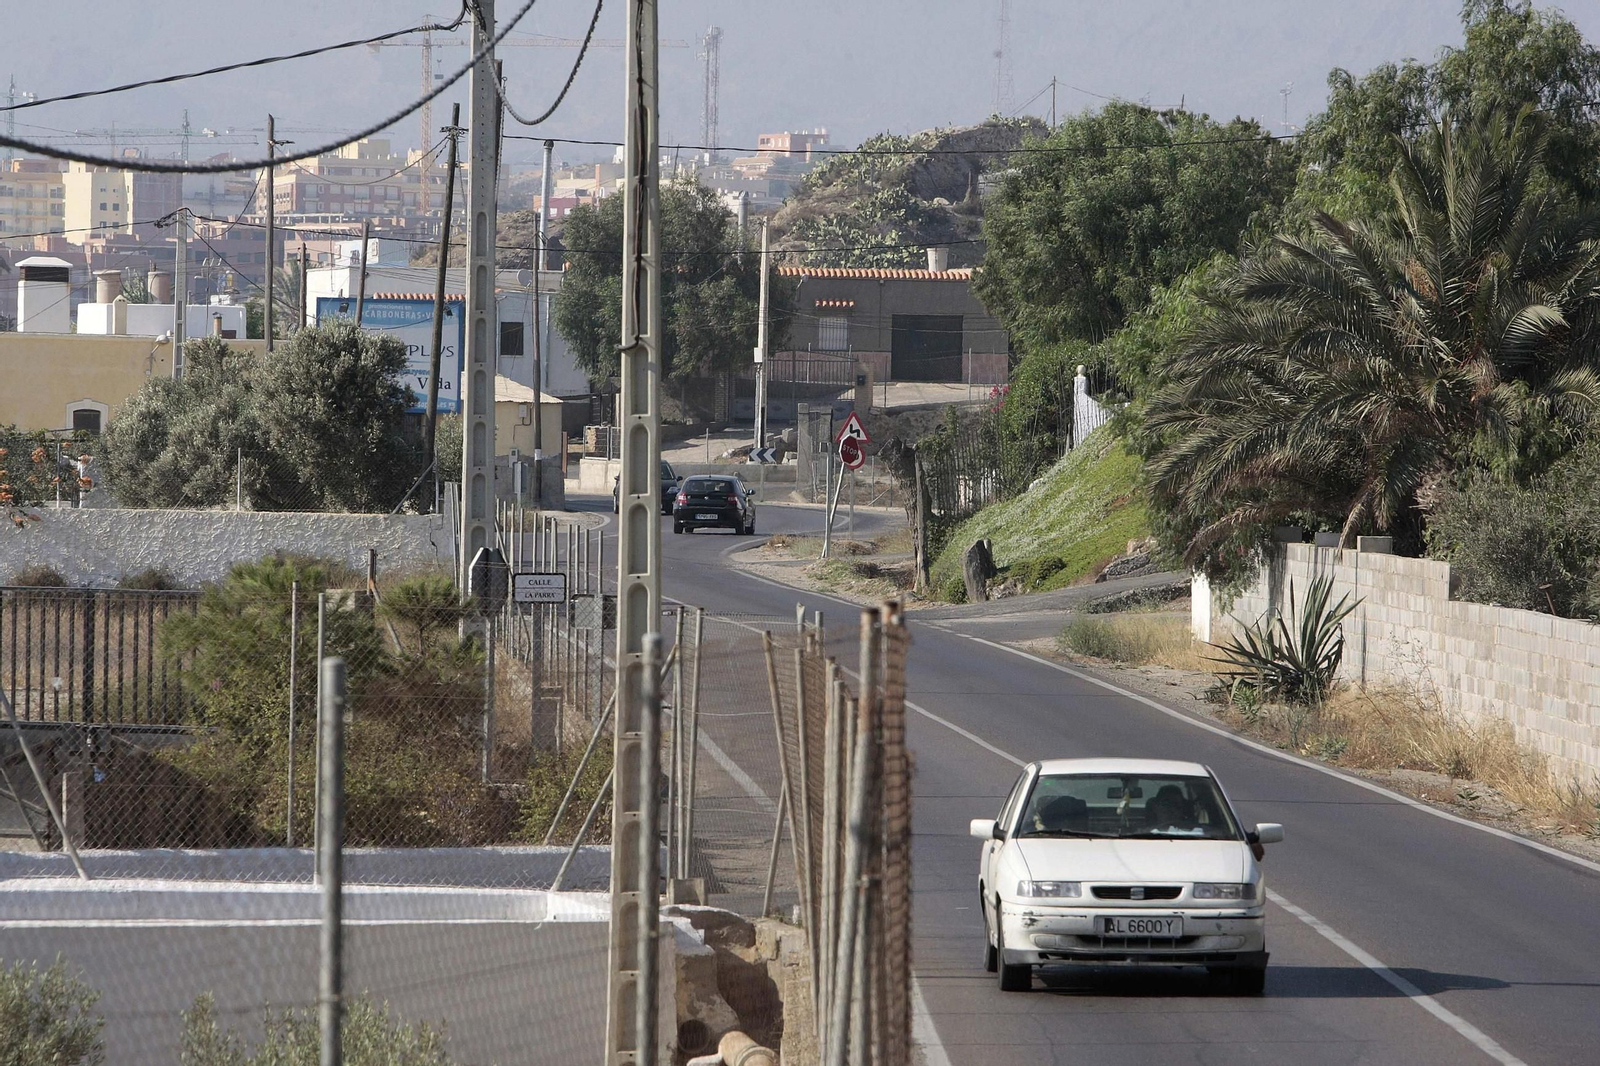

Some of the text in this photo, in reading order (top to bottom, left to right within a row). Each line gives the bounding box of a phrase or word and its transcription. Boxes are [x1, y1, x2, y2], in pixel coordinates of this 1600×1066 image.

[365, 310, 421, 319] CARBONERAS
[417, 376, 451, 390] Vda
[842, 444, 858, 455] STOP
[1128, 919, 1162, 934] 6600
[1165, 919, 1174, 934] Y
